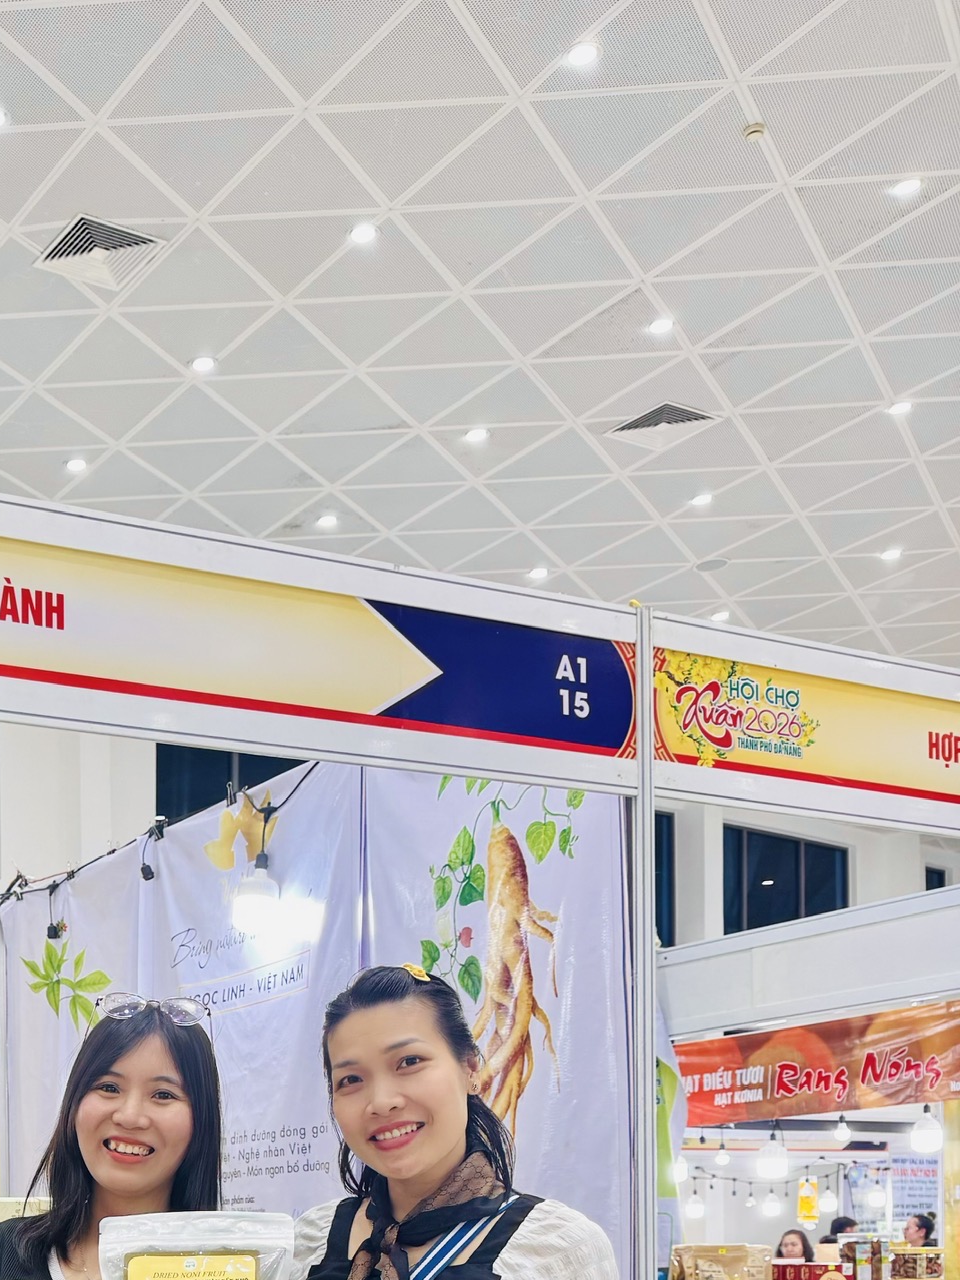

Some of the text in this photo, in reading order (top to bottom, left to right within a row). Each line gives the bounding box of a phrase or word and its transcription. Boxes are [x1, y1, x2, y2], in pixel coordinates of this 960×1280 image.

[556, 655, 587, 684] A1
[559, 688, 591, 719] 15
[729, 677, 800, 711] HỘI CHỢ
[676, 680, 803, 749] Xuân 2026
[170, 928, 212, 969] Bring
[222, 964, 304, 1003] LINH VIỆT NAM
[775, 1062, 848, 1101] Rang
[860, 1047, 942, 1090] Nóng
[714, 1092, 733, 1108] HẠT
[312, 1122, 329, 1139] gói
[238, 1149, 260, 1164] Nghệ
[263, 1146, 285, 1158] nhân
[289, 1142, 312, 1155] Việt
[247, 1164, 263, 1177] Món
[265, 1165, 285, 1179] ngon
[153, 1271, 180, 1279] DRIED
[202, 1270, 227, 1278] FRUIT
